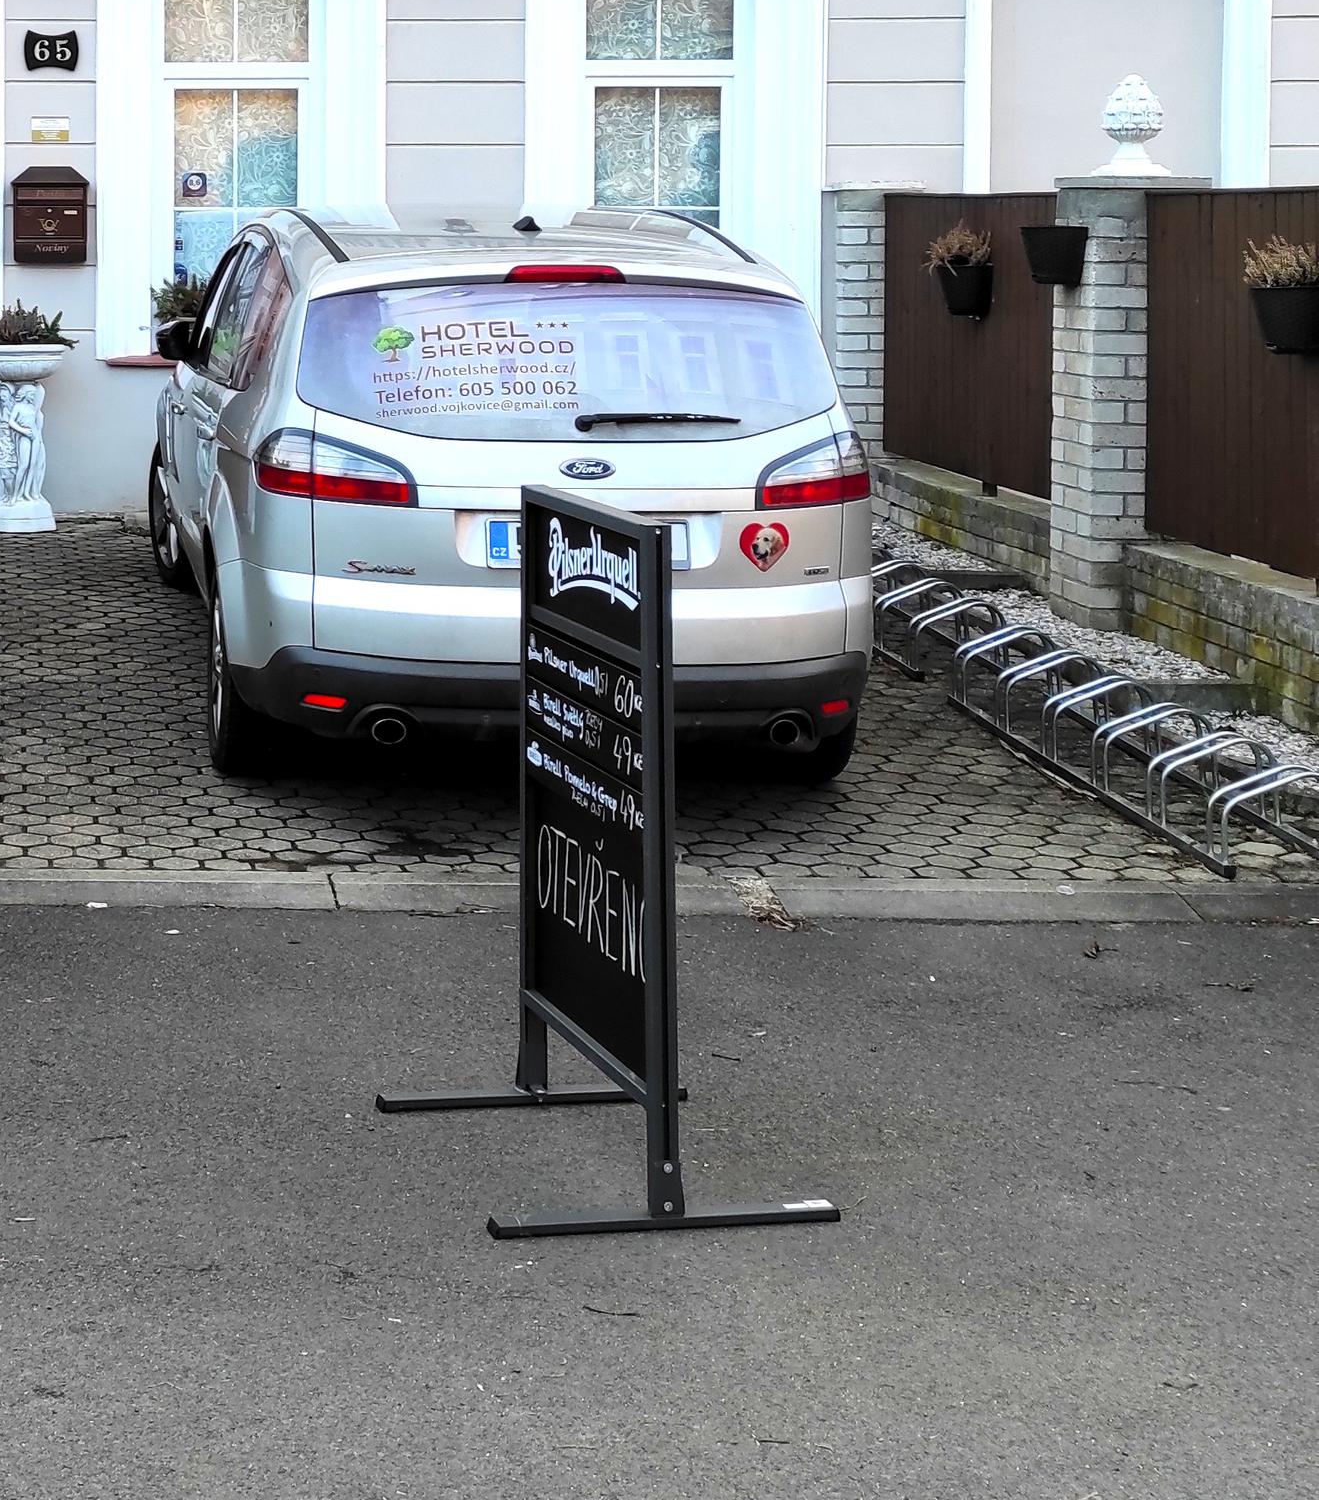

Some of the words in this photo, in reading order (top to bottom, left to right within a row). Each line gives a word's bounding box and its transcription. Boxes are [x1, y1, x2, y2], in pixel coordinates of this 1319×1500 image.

[33, 39, 72, 61] 65
[34, 243, 69, 254] Noviny
[421, 321, 530, 342] HOTEL
[421, 340, 574, 359] SHERWOOD
[373, 361, 576, 384] https://hotelsherwood.cz/
[376, 385, 453, 405] Telefon:
[459, 381, 494, 397] 605
[500, 380, 536, 396] 500
[542, 380, 578, 396] 062
[376, 400, 579, 419] sherwood.vojkovice@gmail.com
[572, 461, 604, 474] Ford
[492, 547, 507, 557] CZ
[548, 517, 591, 597] Pilsner
[589, 526, 638, 604] Urquell
[614, 675, 634, 718] 60
[613, 734, 632, 775] 49
[620, 789, 635, 831] 49
